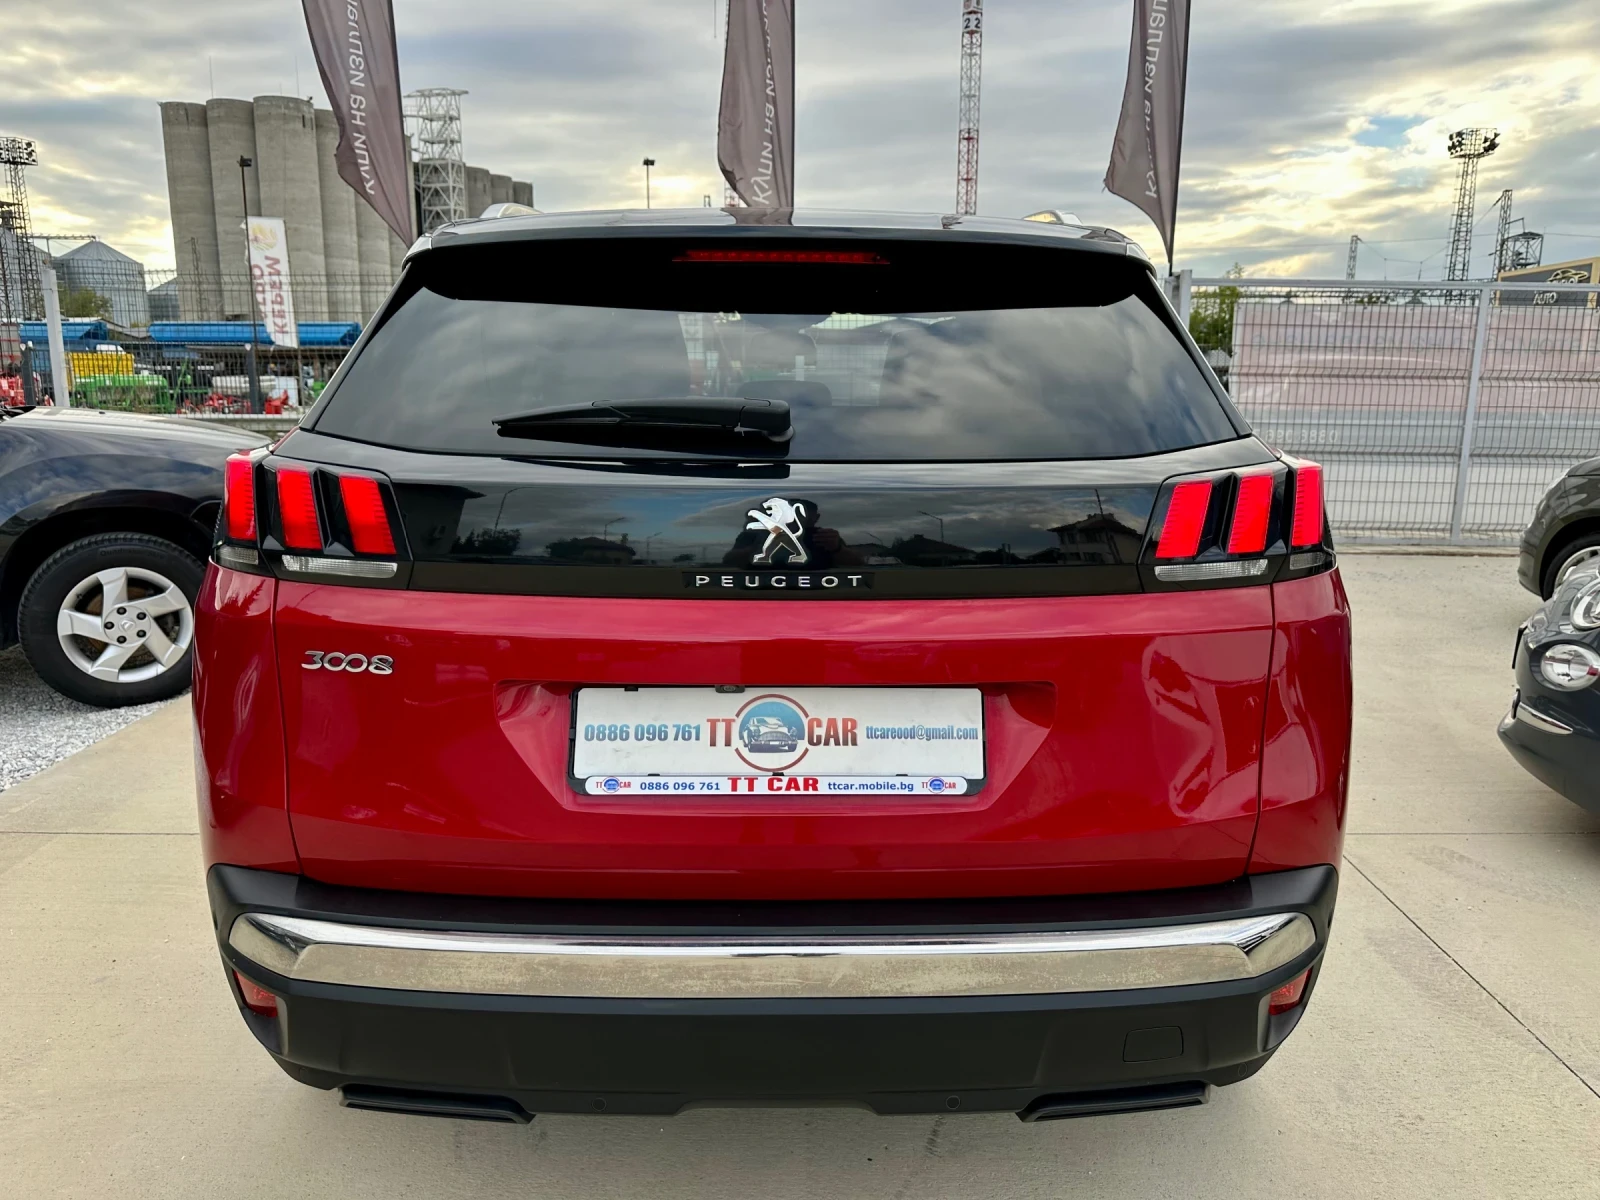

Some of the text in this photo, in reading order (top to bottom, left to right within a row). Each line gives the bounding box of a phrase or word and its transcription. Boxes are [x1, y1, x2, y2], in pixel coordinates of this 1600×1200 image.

[695, 574, 864, 588] PEUGEOT
[301, 650, 394, 676] 3008
[584, 717, 979, 747] 0886 096 761 TT CAR ttcareood@gmail.com
[640, 781, 670, 791] 0886
[672, 781, 696, 791] 096
[699, 781, 721, 791] 761
[727, 777, 763, 792] TT
[767, 777, 819, 792] CAR
[827, 781, 915, 793] ttcar.mobile.bg
